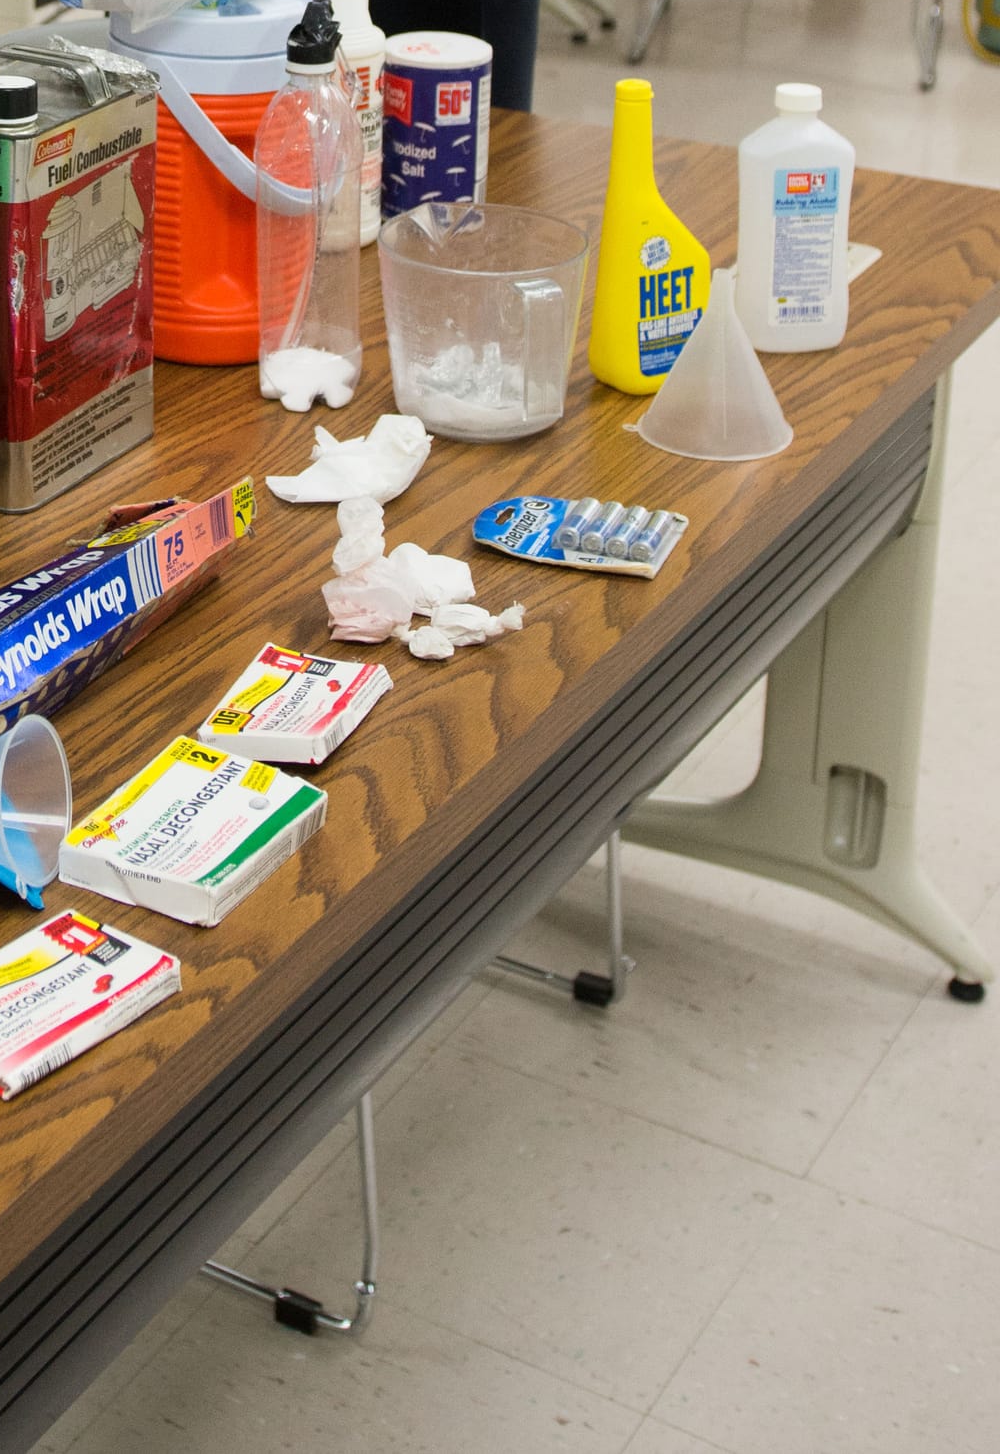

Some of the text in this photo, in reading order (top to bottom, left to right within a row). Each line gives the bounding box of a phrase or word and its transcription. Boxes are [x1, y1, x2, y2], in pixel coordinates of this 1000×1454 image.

[35, 135, 68, 158] Coleman
[47, 126, 142, 188] Fuel/Combustible
[401, 161, 425, 178] Salt
[640, 266, 694, 319] HEET
[163, 530, 184, 563] 75
[497, 510, 539, 548] Energizer
[11, 550, 105, 592] Wrap
[66, 575, 127, 633] Wrap
[212, 710, 240, 726] DG
[277, 676, 319, 720] DECONGESTANT
[82, 818, 128, 848] Guarantee
[117, 831, 150, 858] MAXIMUM
[148, 799, 186, 833] STRENGTH
[126, 836, 169, 866] NASAL
[160, 760, 246, 837] DECONGESTANT
[122, 869, 146, 882] OTHER
[146, 873, 162, 884] END
[4, 962, 92, 1020] DECONGESTANT
